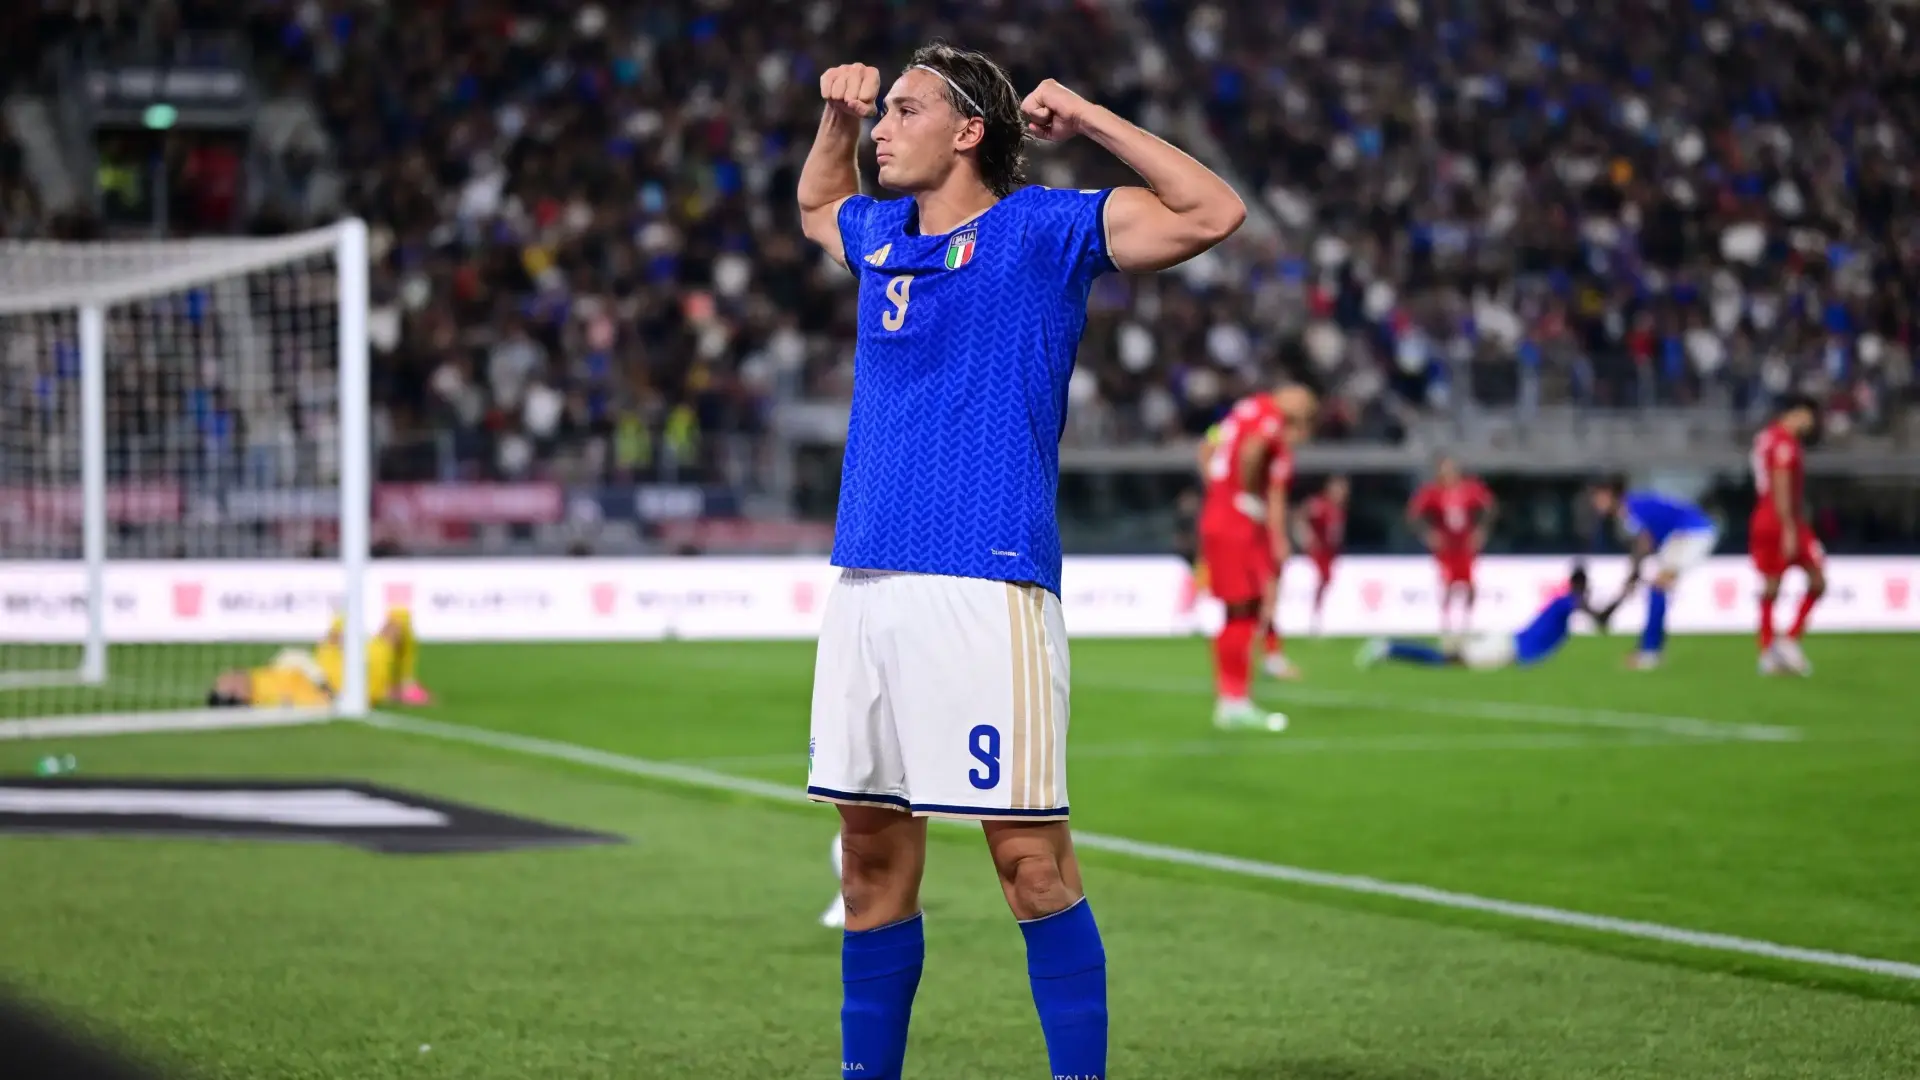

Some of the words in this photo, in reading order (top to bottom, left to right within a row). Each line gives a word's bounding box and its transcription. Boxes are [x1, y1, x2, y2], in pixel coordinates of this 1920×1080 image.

[951, 231, 975, 246] ITALIA
[882, 275, 914, 331] 9
[969, 724, 1000, 790] 9
